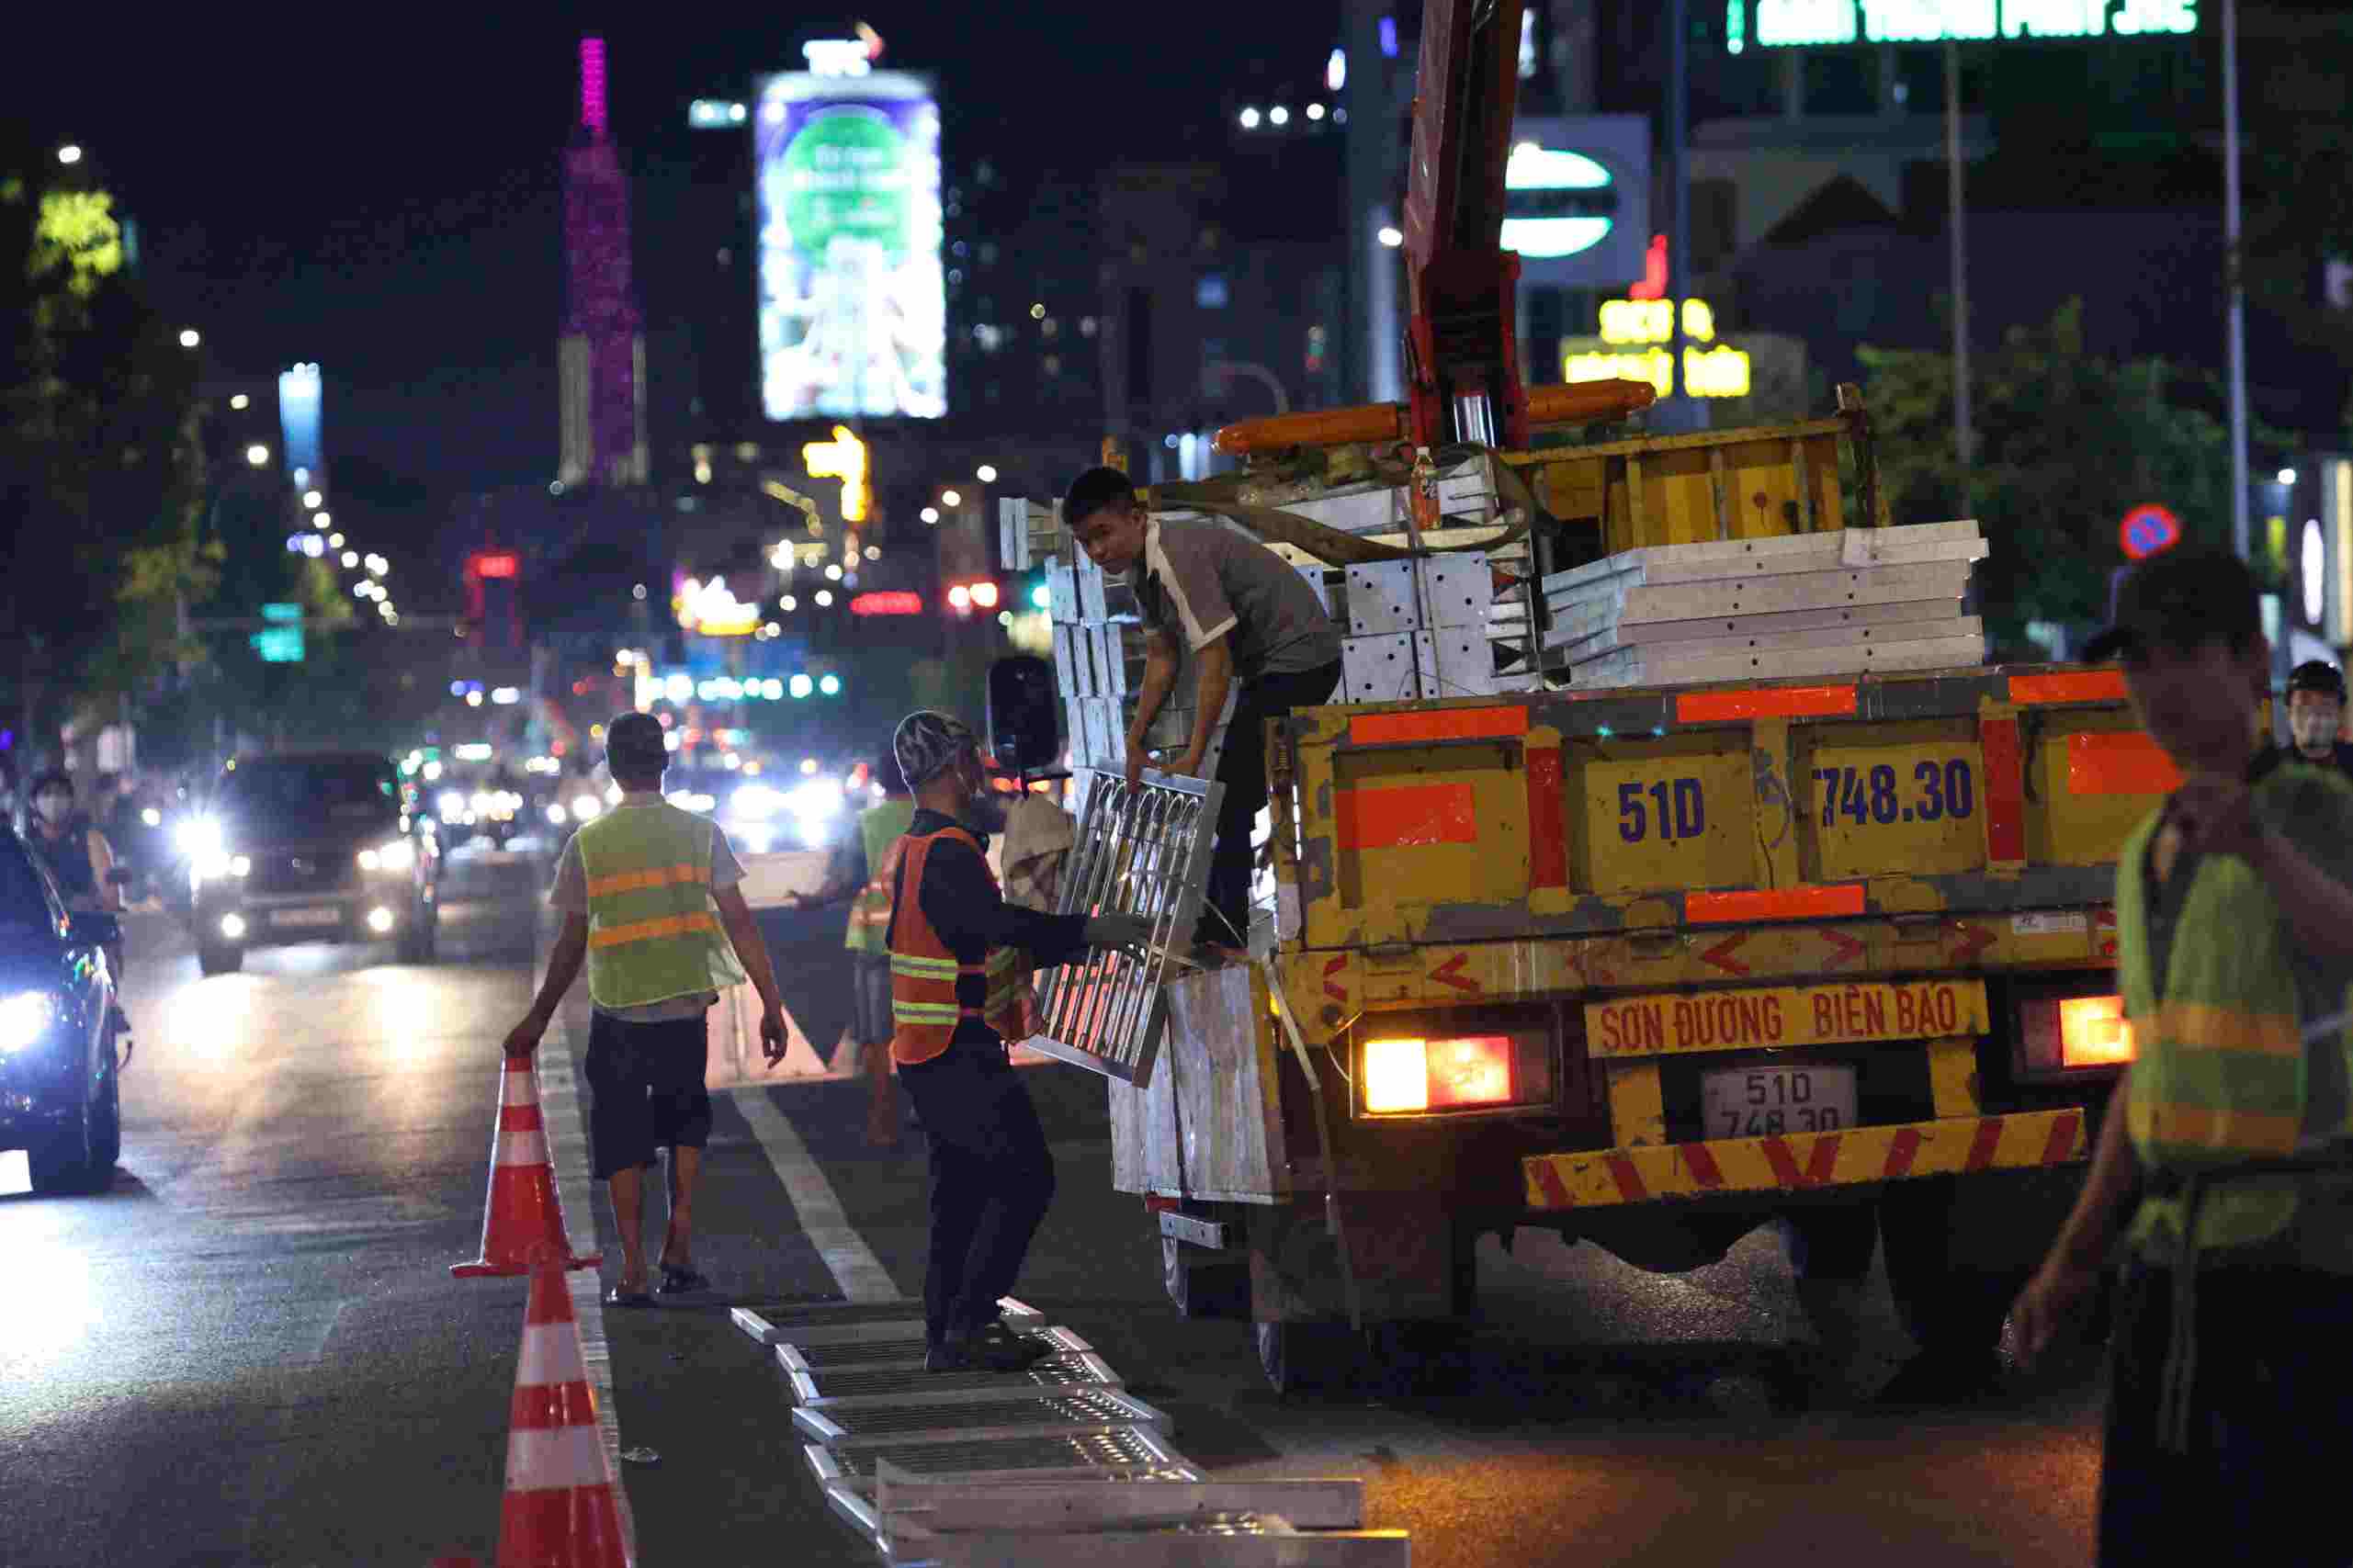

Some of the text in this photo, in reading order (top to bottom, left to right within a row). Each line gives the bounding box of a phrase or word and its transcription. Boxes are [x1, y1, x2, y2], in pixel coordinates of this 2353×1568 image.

[1617, 758, 1973, 843] 51D 748.30
[1746, 1073, 1812, 1104] 51D
